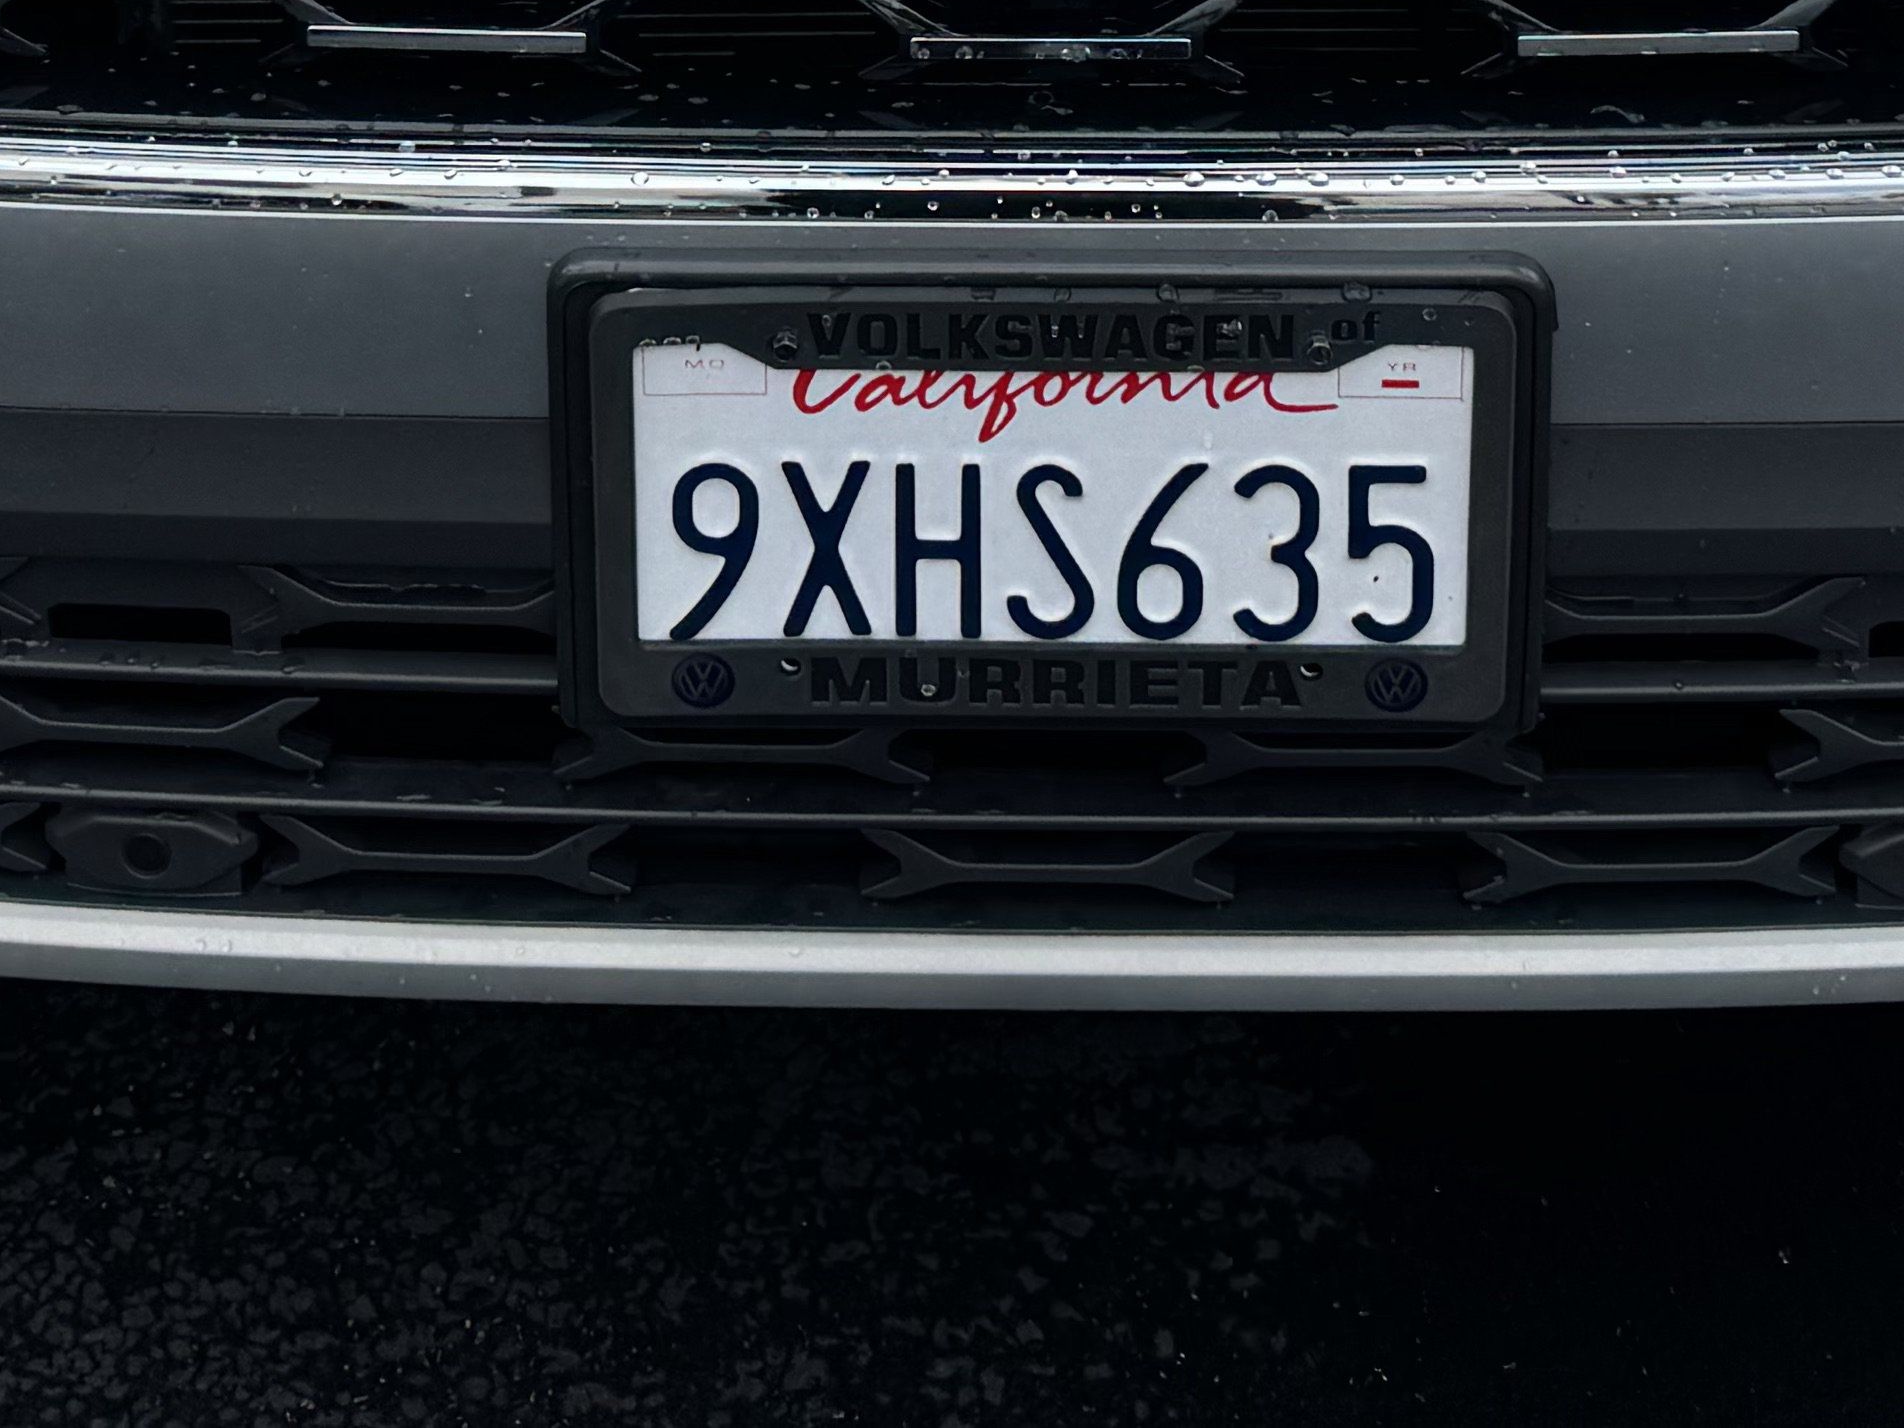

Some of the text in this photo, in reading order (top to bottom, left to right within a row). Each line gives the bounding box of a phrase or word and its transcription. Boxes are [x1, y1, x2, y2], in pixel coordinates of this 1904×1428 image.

[806, 310, 1381, 360] VOLKSWAGEN of
[684, 359, 724, 369] MO
[1388, 361, 1416, 371] YR
[668, 459, 1435, 644] 9XHS635
[809, 655, 1301, 707] MURRIETA
